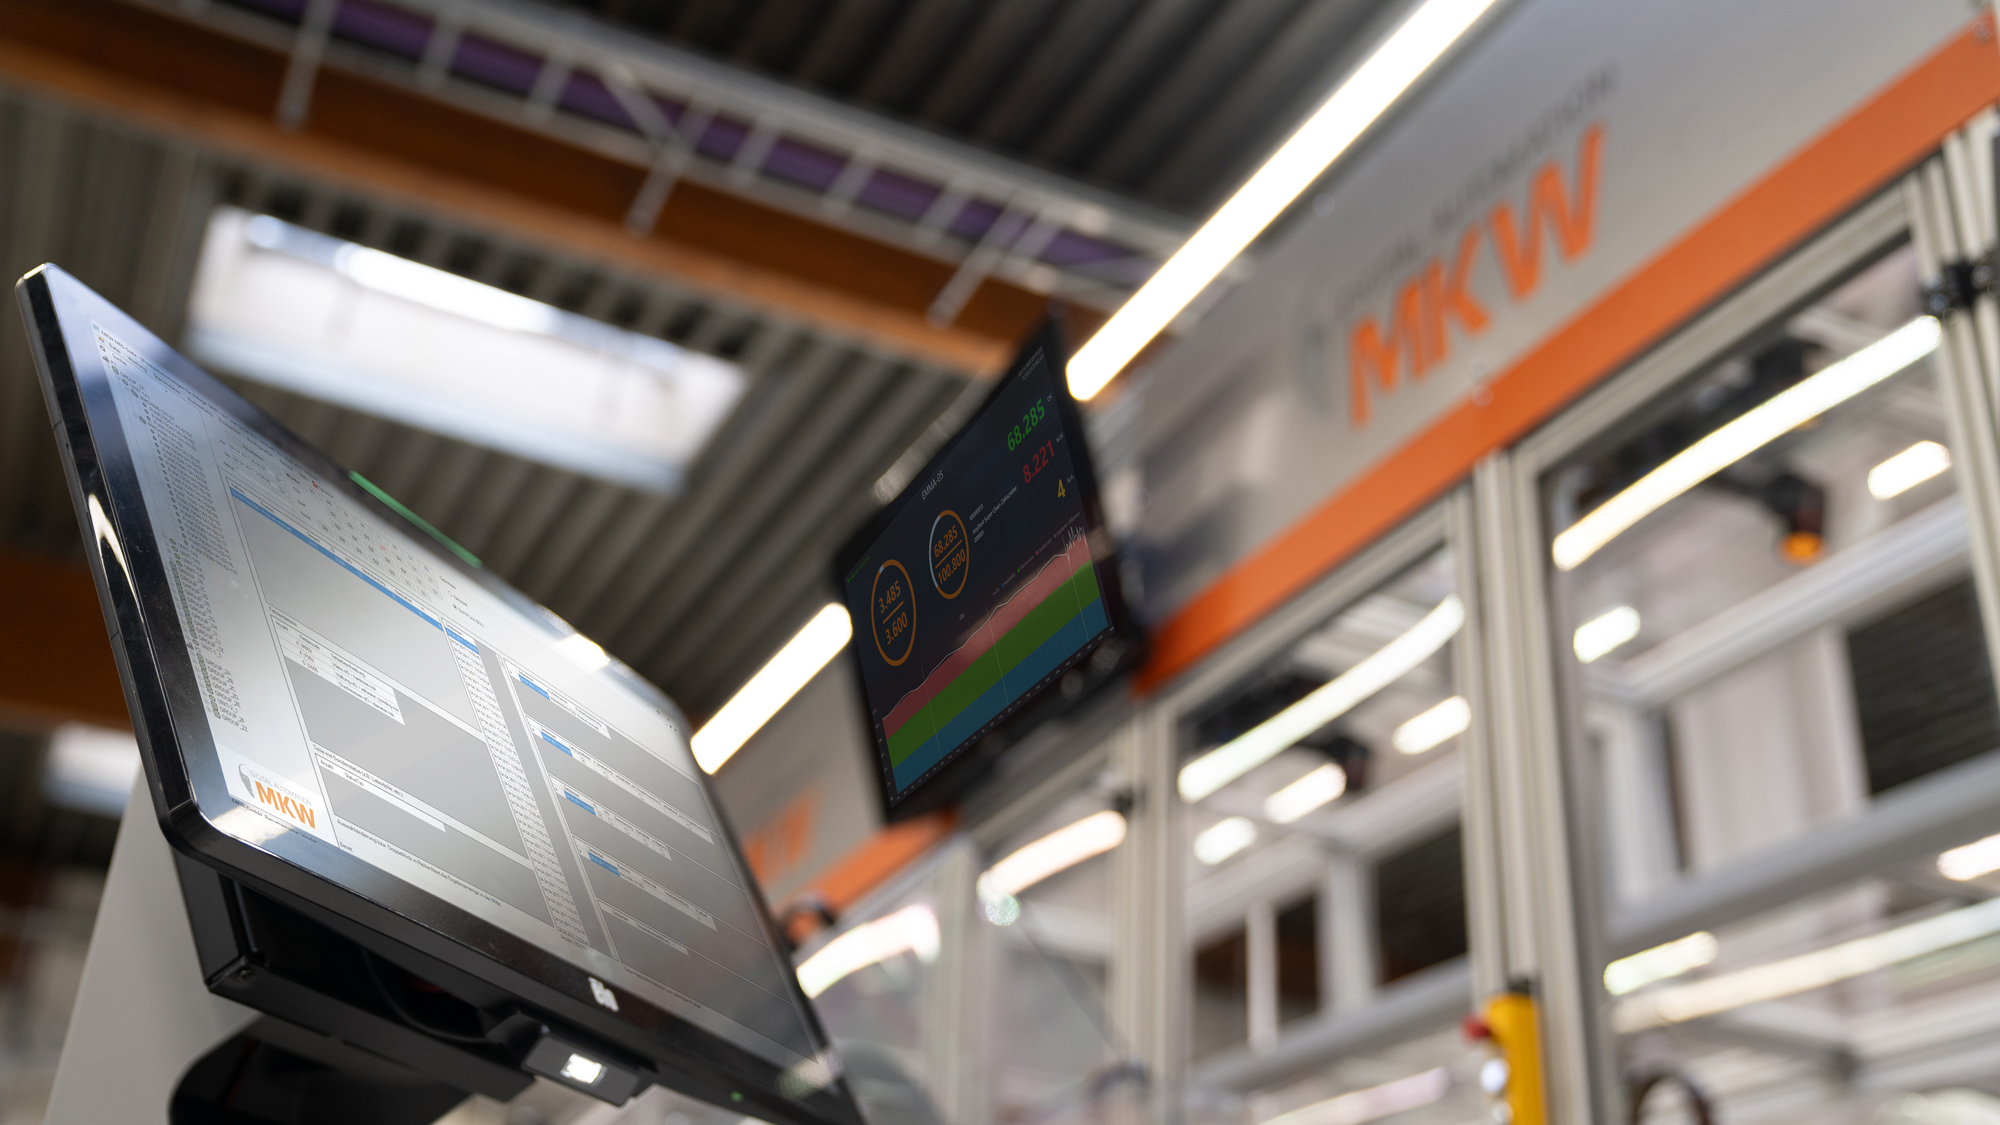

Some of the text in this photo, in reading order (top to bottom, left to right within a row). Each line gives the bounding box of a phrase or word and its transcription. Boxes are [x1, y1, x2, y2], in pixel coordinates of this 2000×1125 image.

[1350, 119, 1604, 427] MKW
[1005, 396, 1046, 454] 68.285
[1046, 391, 1053, 403] OK
[1021, 430, 1065, 486] 8.221 NOK
[920, 467, 944, 503] EMMA-05
[1054, 476, 1067, 503] 4
[982, 508, 993, 525] Super
[991, 499, 1001, 515] Clean
[932, 521, 958, 561] 68.285
[936, 544, 967, 588] 100.800
[877, 577, 901, 615] 3.485
[884, 609, 909, 647] 3.600
[248, 769, 312, 807] DIGITAL AUTOMATION
[253, 779, 319, 831] MKW
